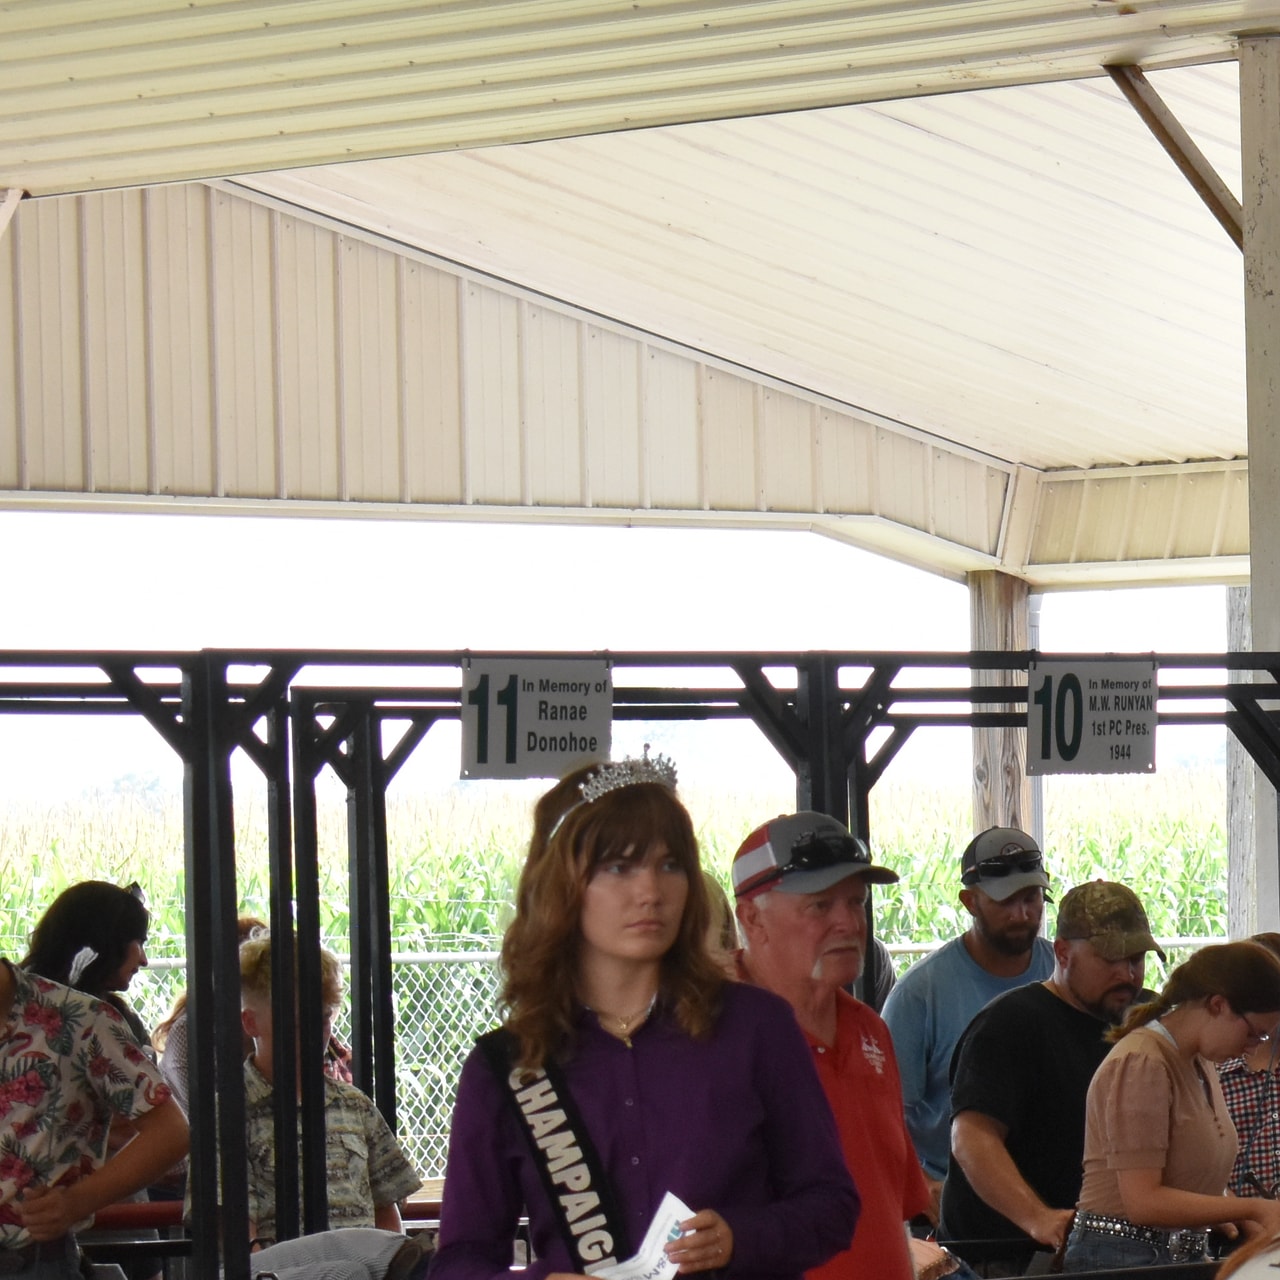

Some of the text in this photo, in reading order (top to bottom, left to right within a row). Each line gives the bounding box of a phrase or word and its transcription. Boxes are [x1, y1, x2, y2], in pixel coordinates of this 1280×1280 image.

[522, 679, 608, 695] In Memory of
[1089, 678, 1152, 692] In Memory of
[538, 700, 588, 721] Ranae
[1089, 695, 1153, 712] M.W. RUNYAN
[467, 674, 519, 764] 11
[1034, 672, 1083, 762] 10
[1092, 720, 1150, 736] 1st PC Pres.
[527, 732, 598, 753] Donohoe
[1110, 744, 1131, 760] 1944
